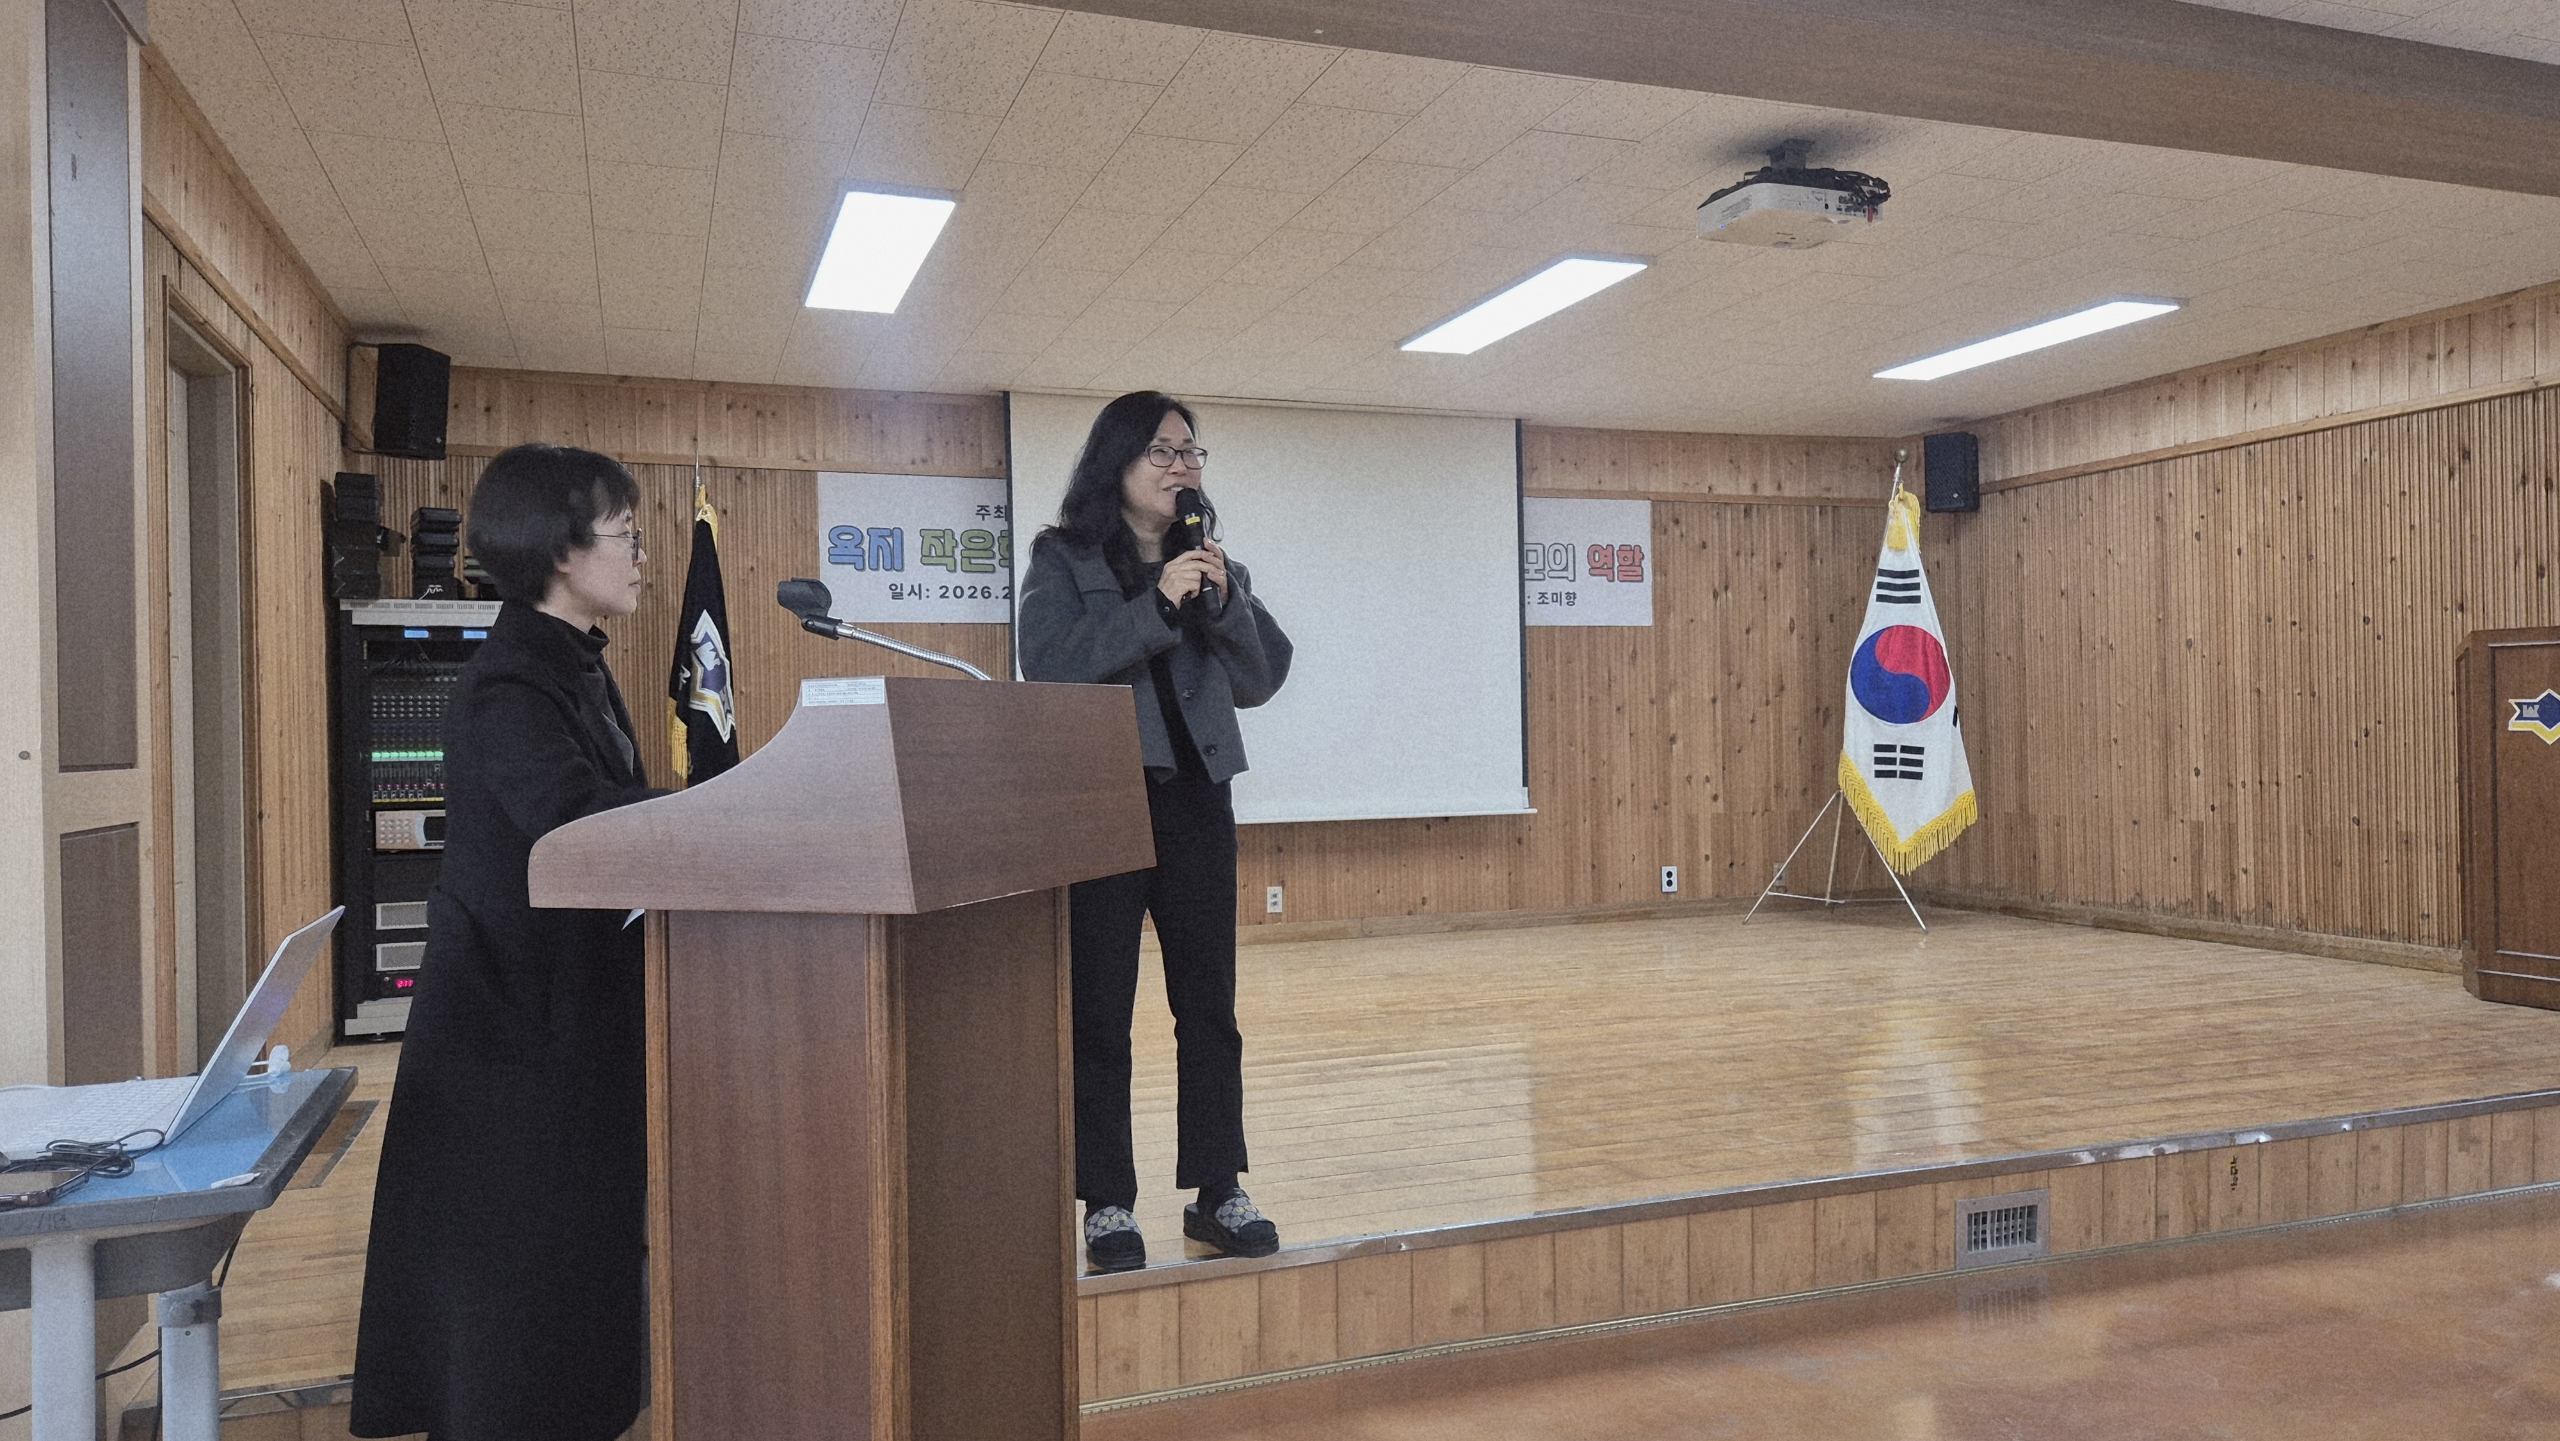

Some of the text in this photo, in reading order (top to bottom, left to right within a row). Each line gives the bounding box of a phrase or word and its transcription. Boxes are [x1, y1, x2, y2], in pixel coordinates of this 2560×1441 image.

[828, 525, 905, 573] 욕지
[1587, 544, 1645, 583] 역할
[888, 583, 931, 601] 일시:
[1536, 591, 1578, 607] 조미향
